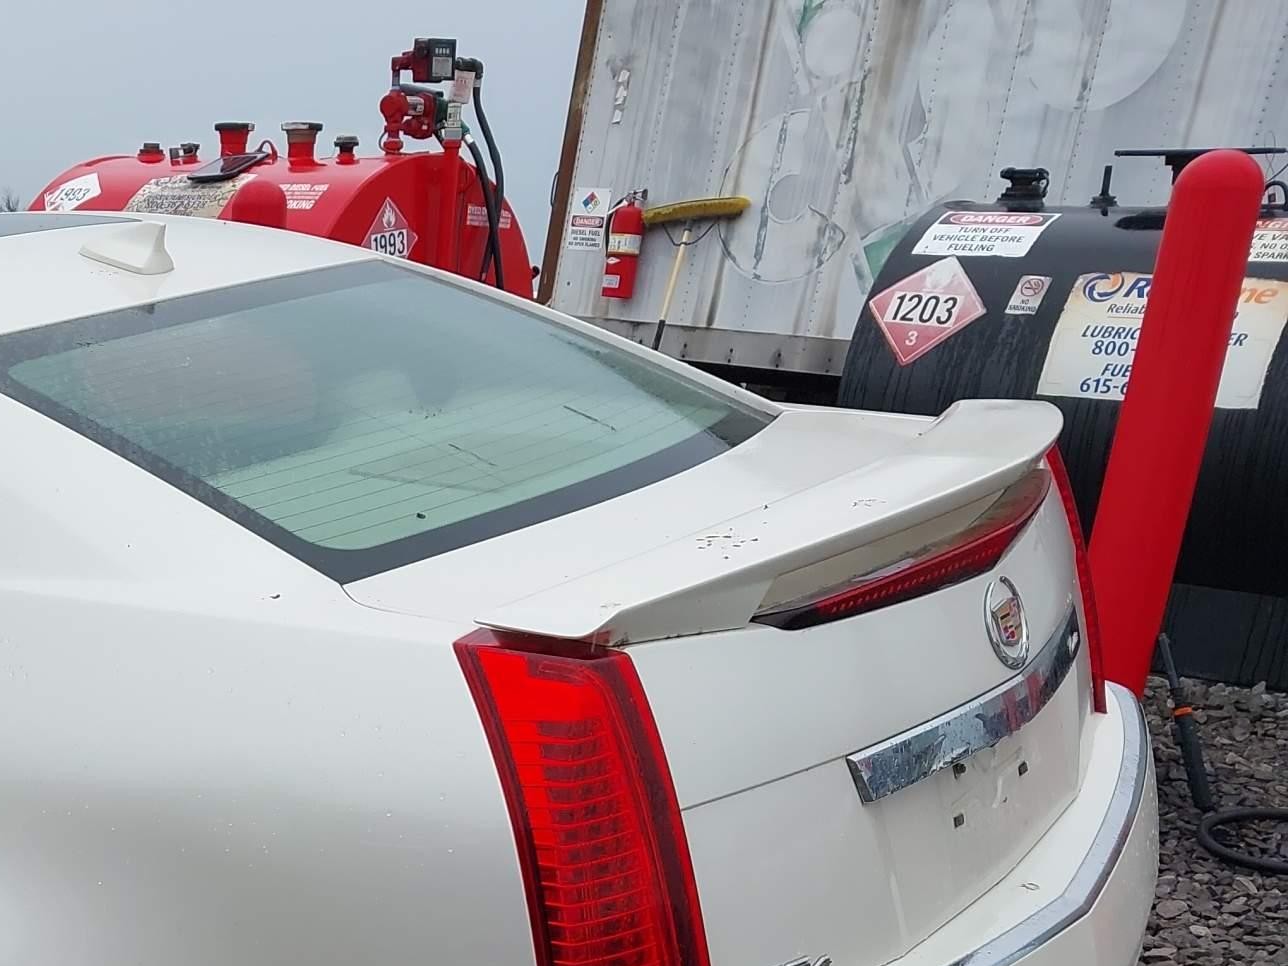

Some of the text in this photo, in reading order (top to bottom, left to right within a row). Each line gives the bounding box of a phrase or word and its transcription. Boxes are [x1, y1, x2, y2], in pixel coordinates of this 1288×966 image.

[962, 214, 1031, 224] DANGER
[958, 226, 988, 234] TURN
[933, 234, 1025, 243] VEHICLE BEFORE
[372, 231, 406, 256] 1993
[946, 243, 995, 252] FUELING
[891, 293, 958, 325] 1203
[1007, 304, 1037, 312] SMOKING
[905, 331, 918, 345] 3
